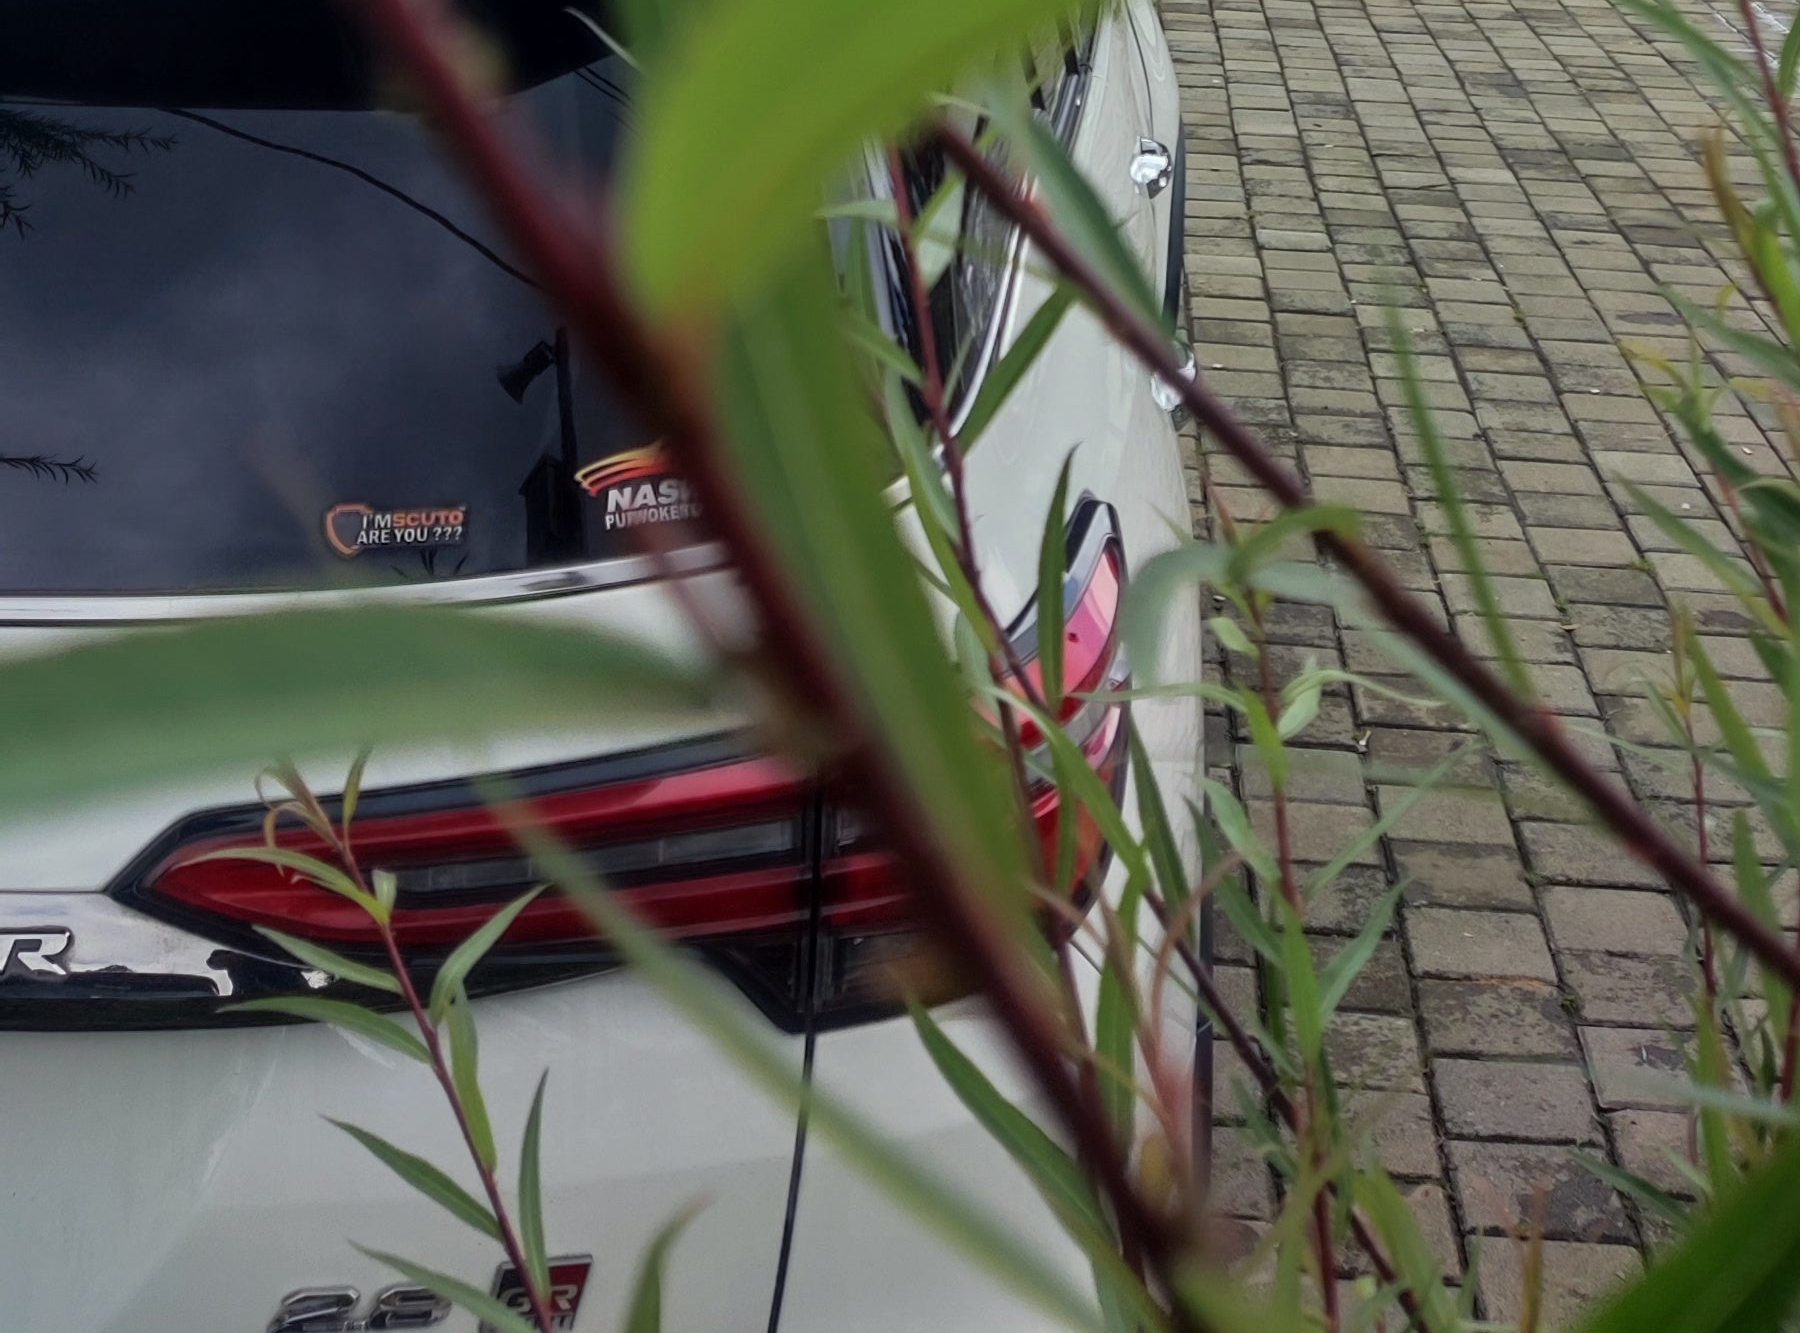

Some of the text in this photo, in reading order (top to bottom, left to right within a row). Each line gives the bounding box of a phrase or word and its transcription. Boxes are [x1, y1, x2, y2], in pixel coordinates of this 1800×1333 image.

[605, 503, 704, 531] PURWOKERO
[356, 530, 391, 544] ARE
[394, 527, 428, 542] YOU
